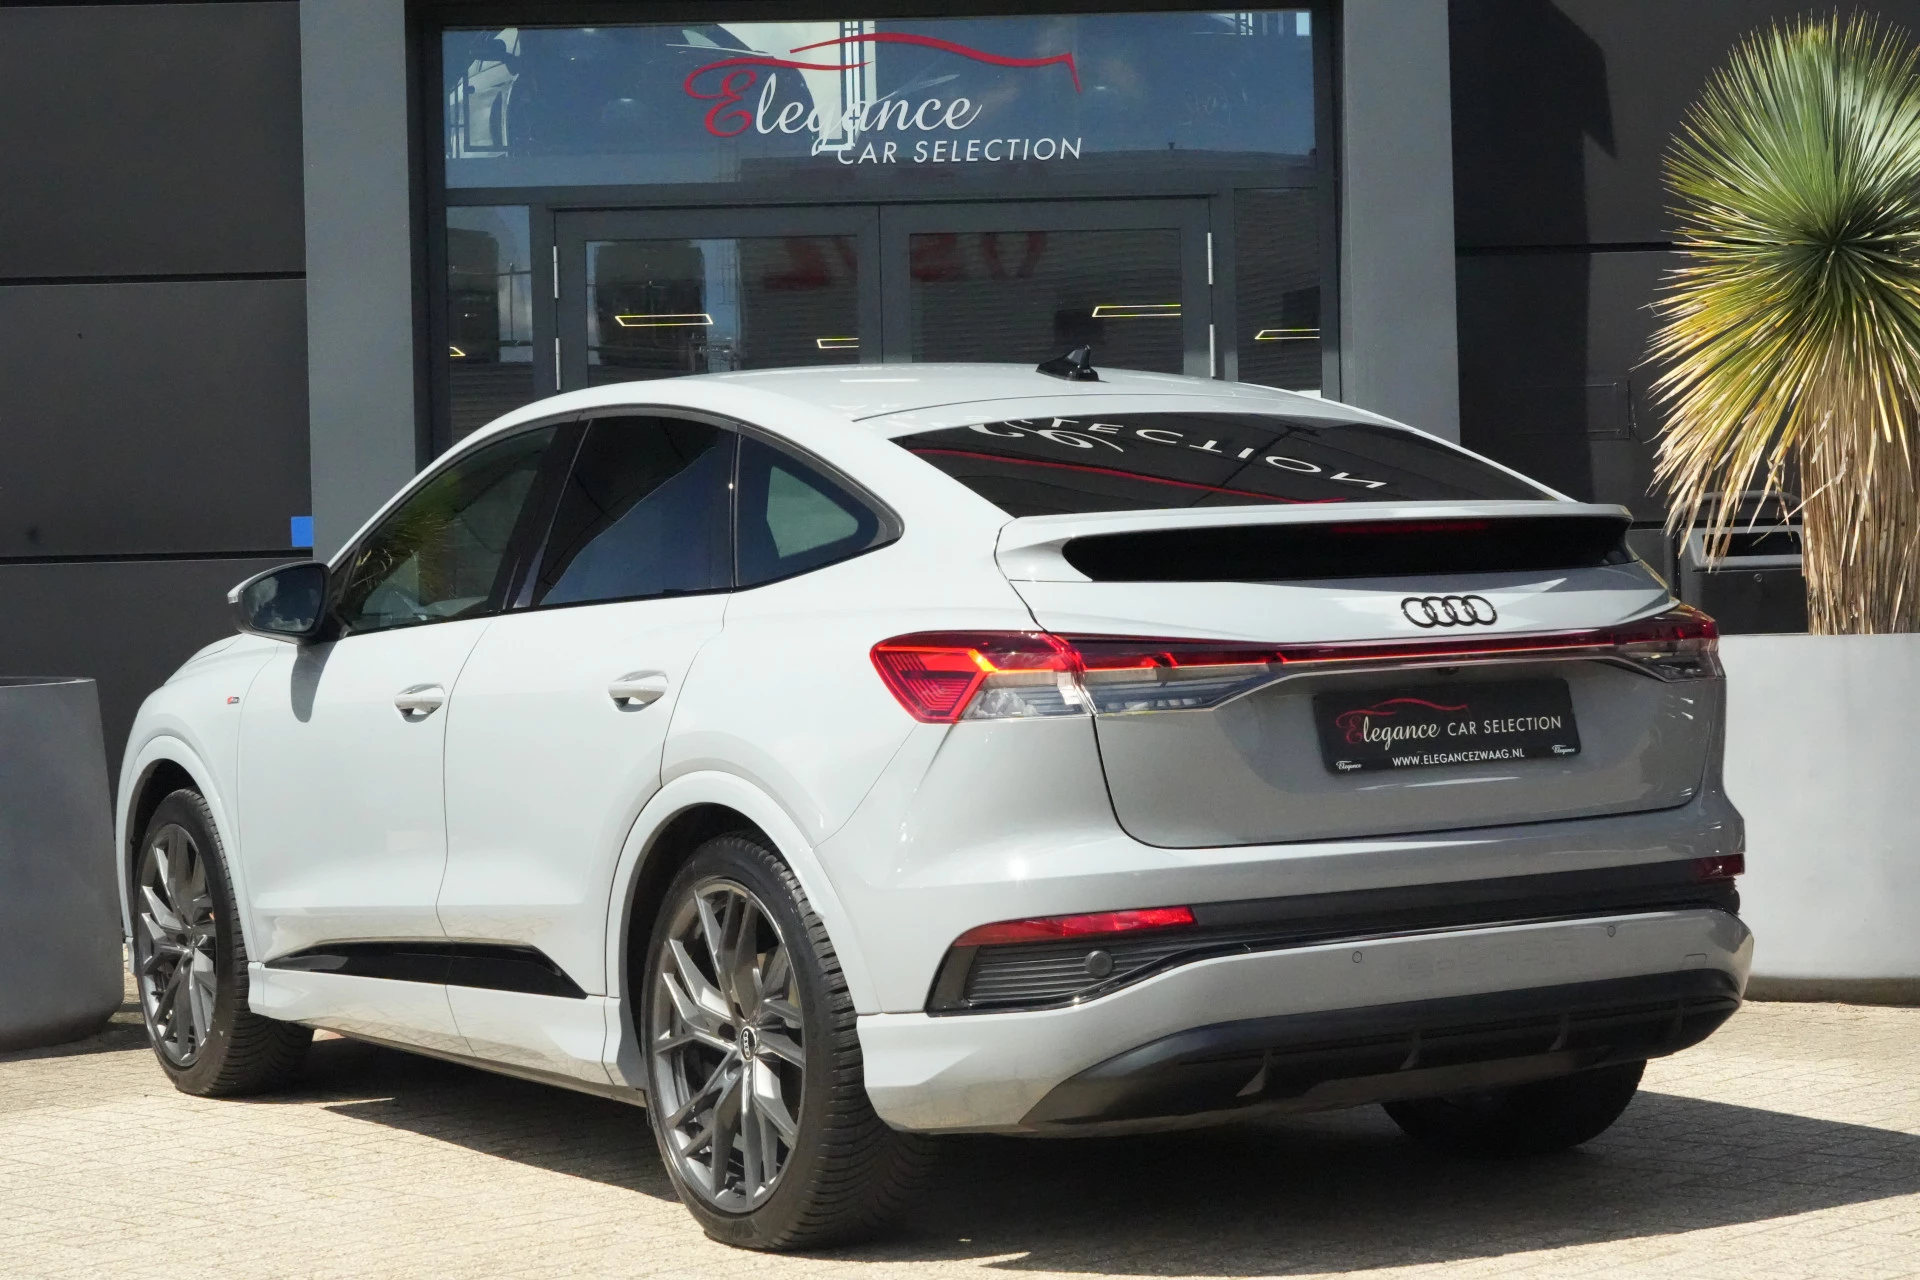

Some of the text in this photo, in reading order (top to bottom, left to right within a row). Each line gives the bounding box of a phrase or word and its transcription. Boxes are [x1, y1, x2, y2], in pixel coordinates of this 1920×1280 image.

[684, 57, 983, 157] Elegance
[837, 137, 1082, 165] CAR SELECTION
[1336, 710, 1562, 750] Elegance CAR SELECTION
[1392, 748, 1525, 767] WWW.ELEGANCEZWAAG.NL
